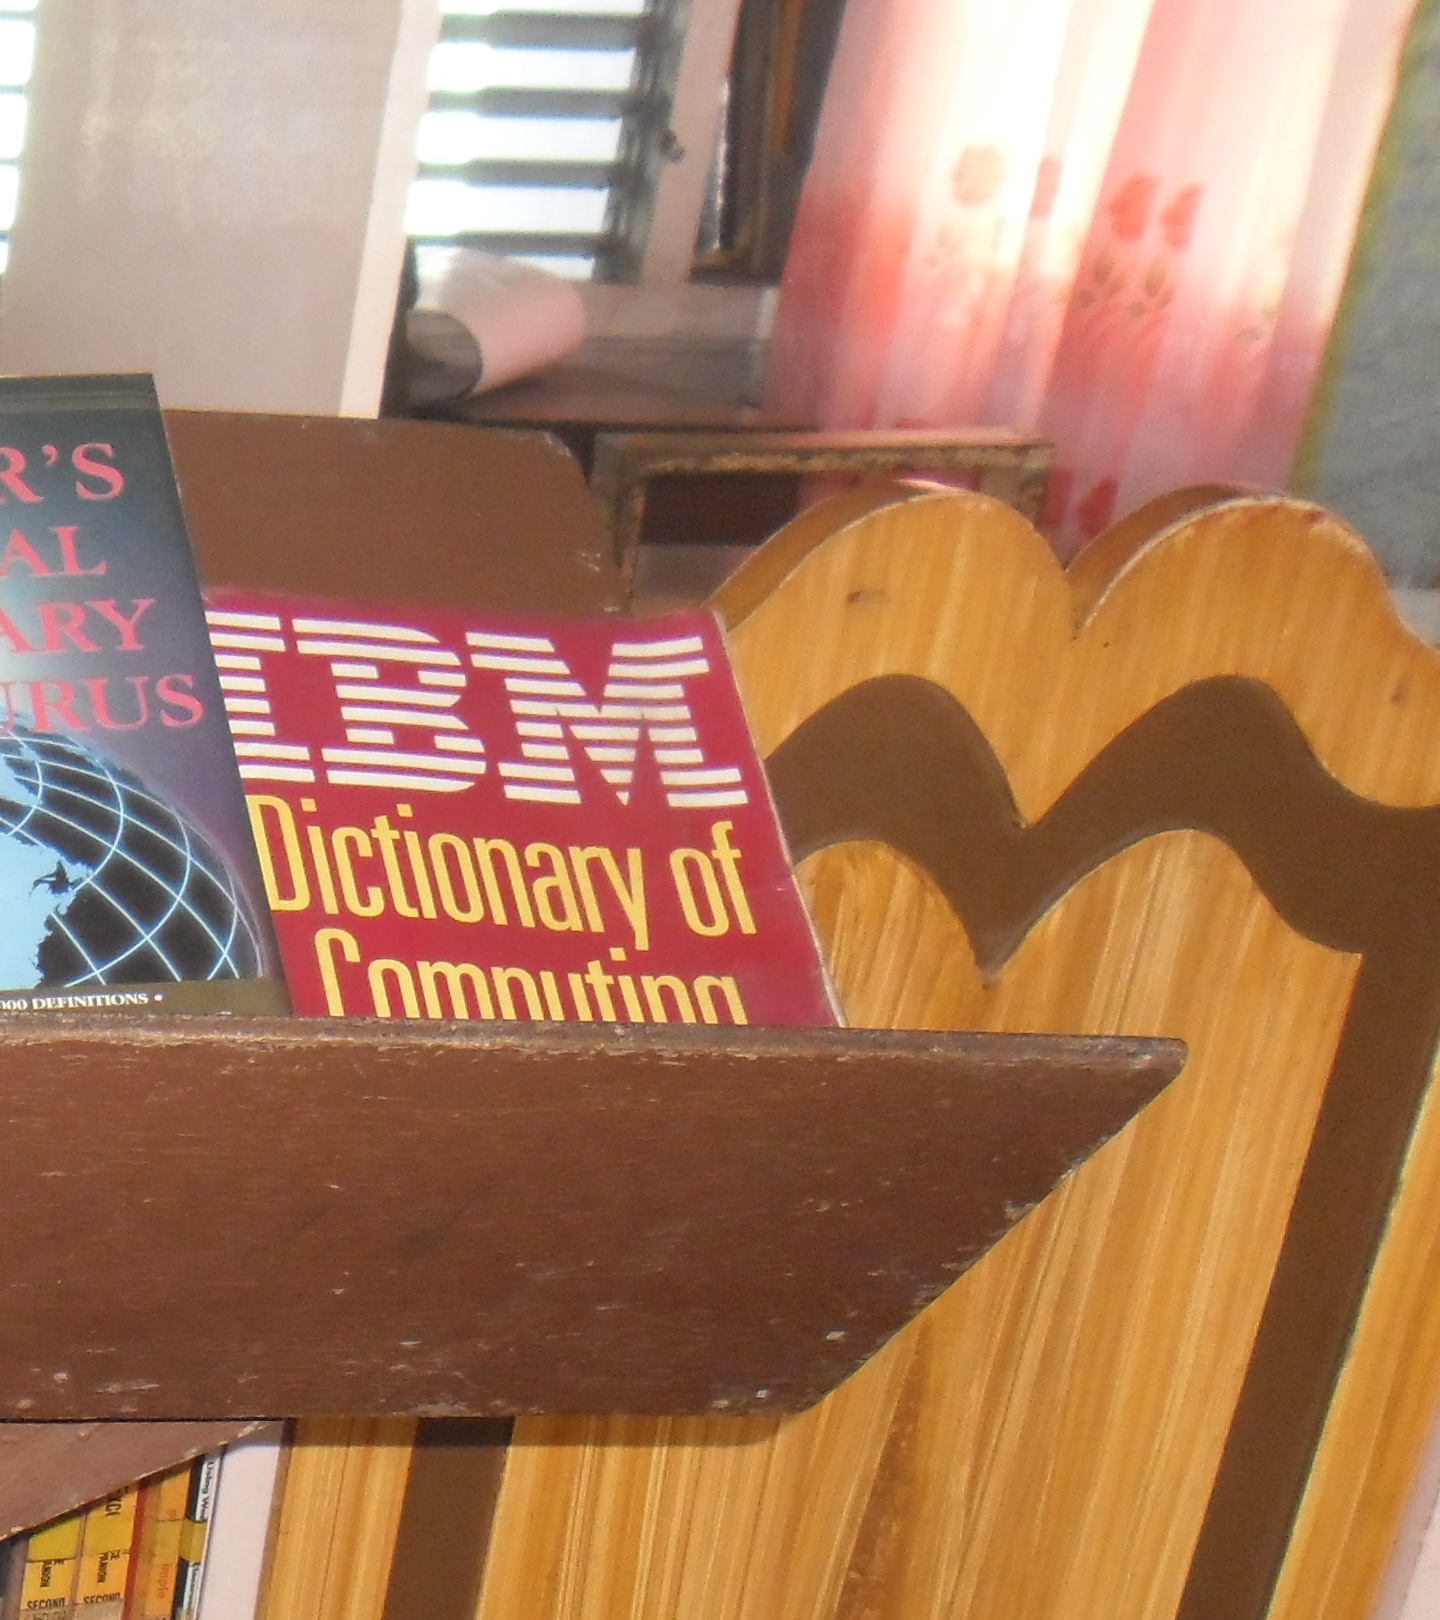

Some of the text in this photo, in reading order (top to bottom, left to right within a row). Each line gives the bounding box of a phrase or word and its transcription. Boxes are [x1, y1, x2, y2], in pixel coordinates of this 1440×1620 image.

[205, 609, 747, 808] IBM
[246, 795, 757, 952] Dictionary of
[32, 992, 149, 1010] DEFINITIONS
